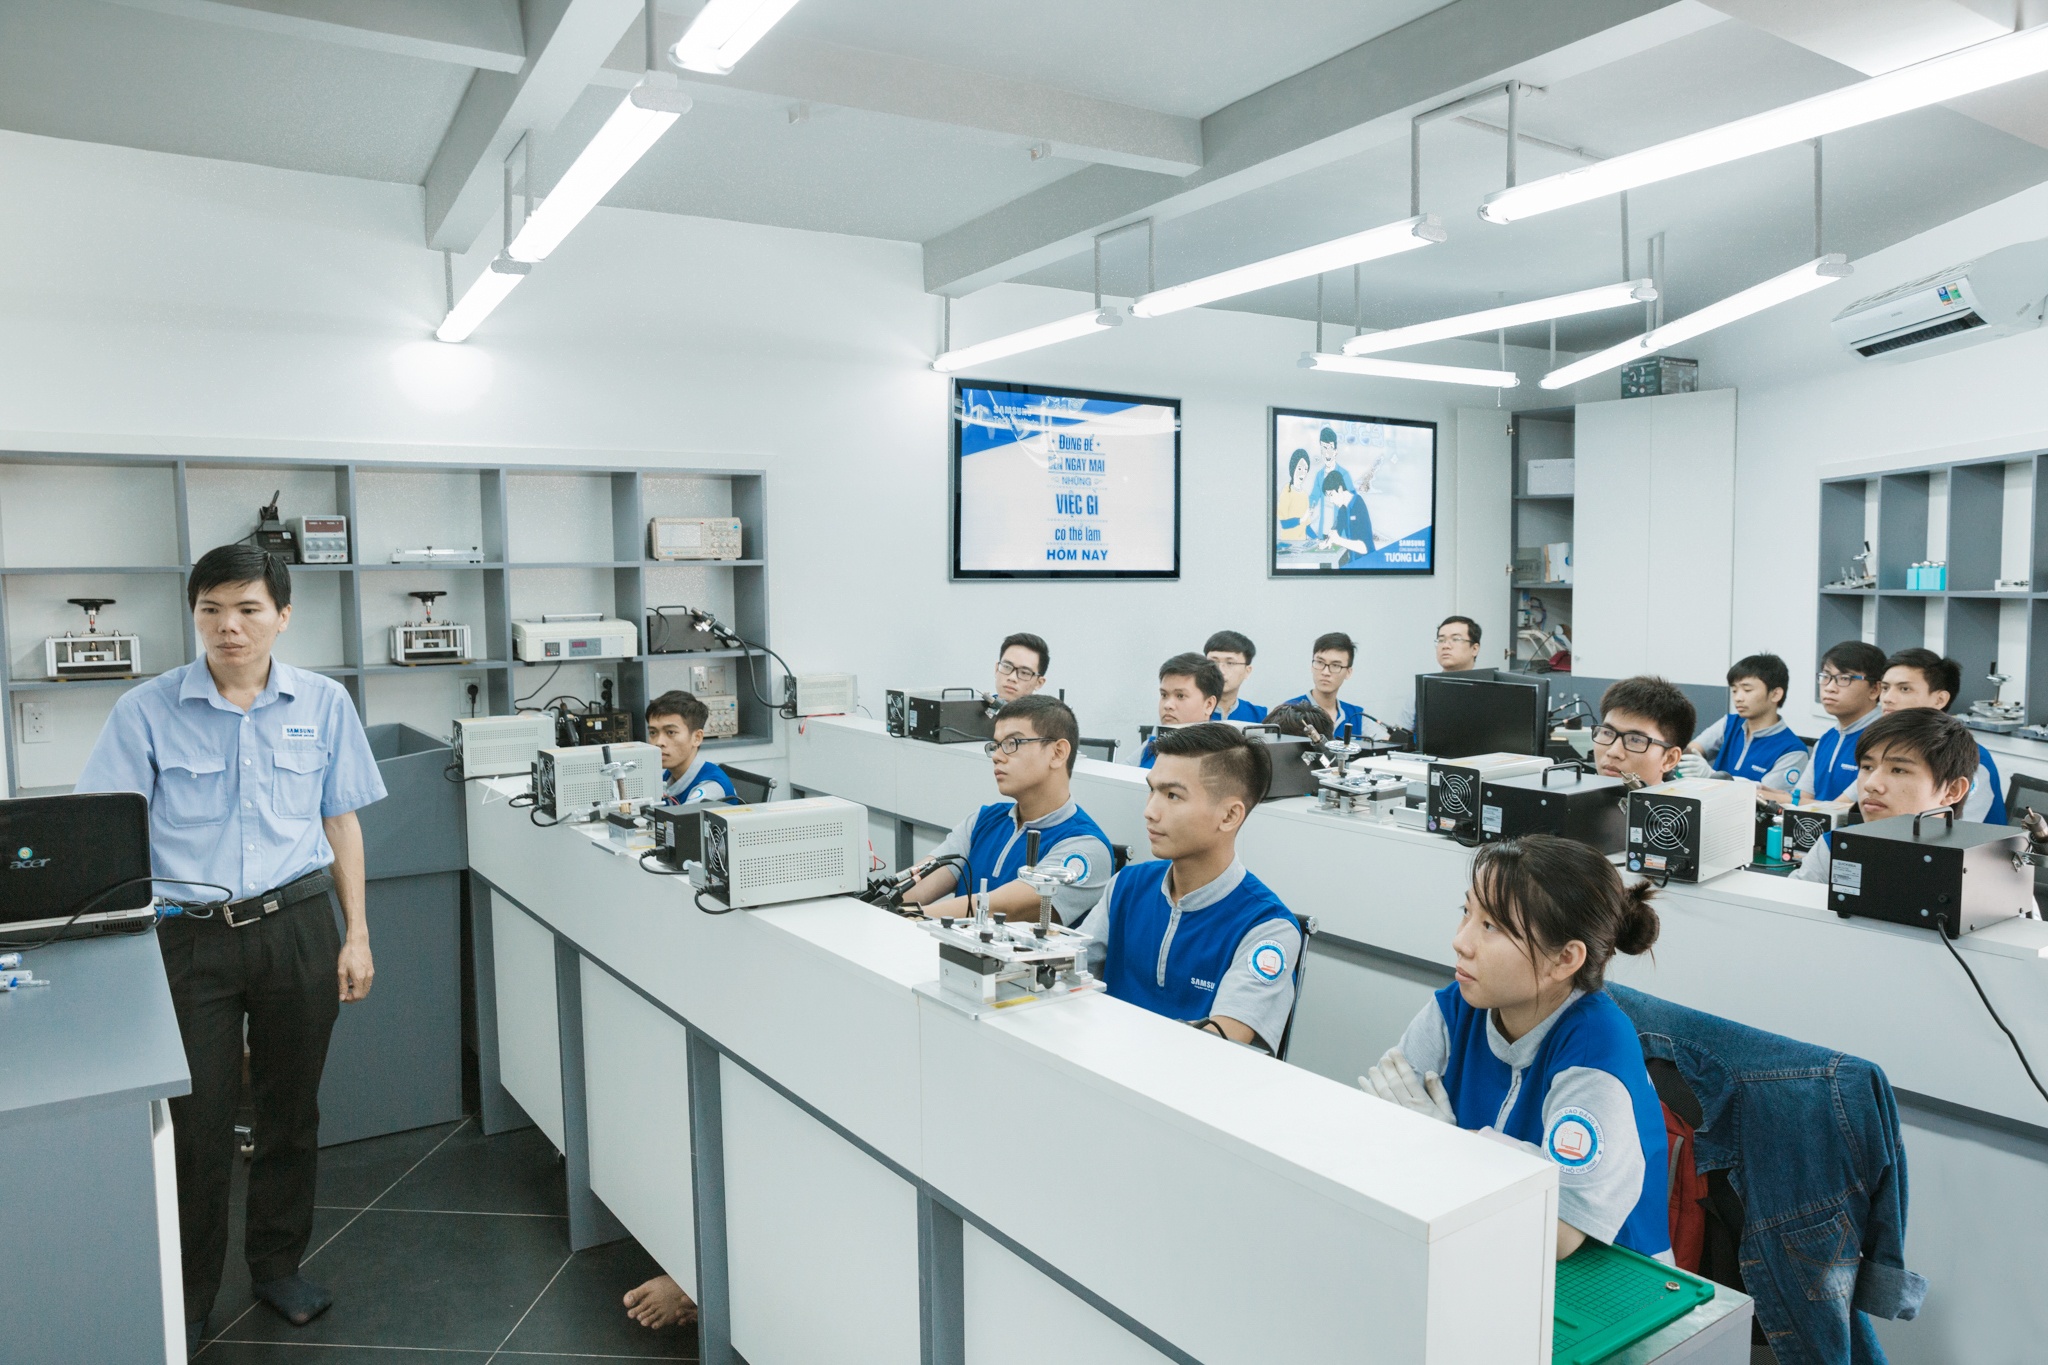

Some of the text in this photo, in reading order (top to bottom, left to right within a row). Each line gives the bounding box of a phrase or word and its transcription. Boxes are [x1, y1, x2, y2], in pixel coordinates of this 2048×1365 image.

[1089, 459, 1104, 472] MAI
[1047, 546, 1108, 560] HÔM NAY
[1413, 553, 1426, 562] LAI
[10, 858, 51, 869] acer
[1191, 977, 1215, 989] SAMSU
